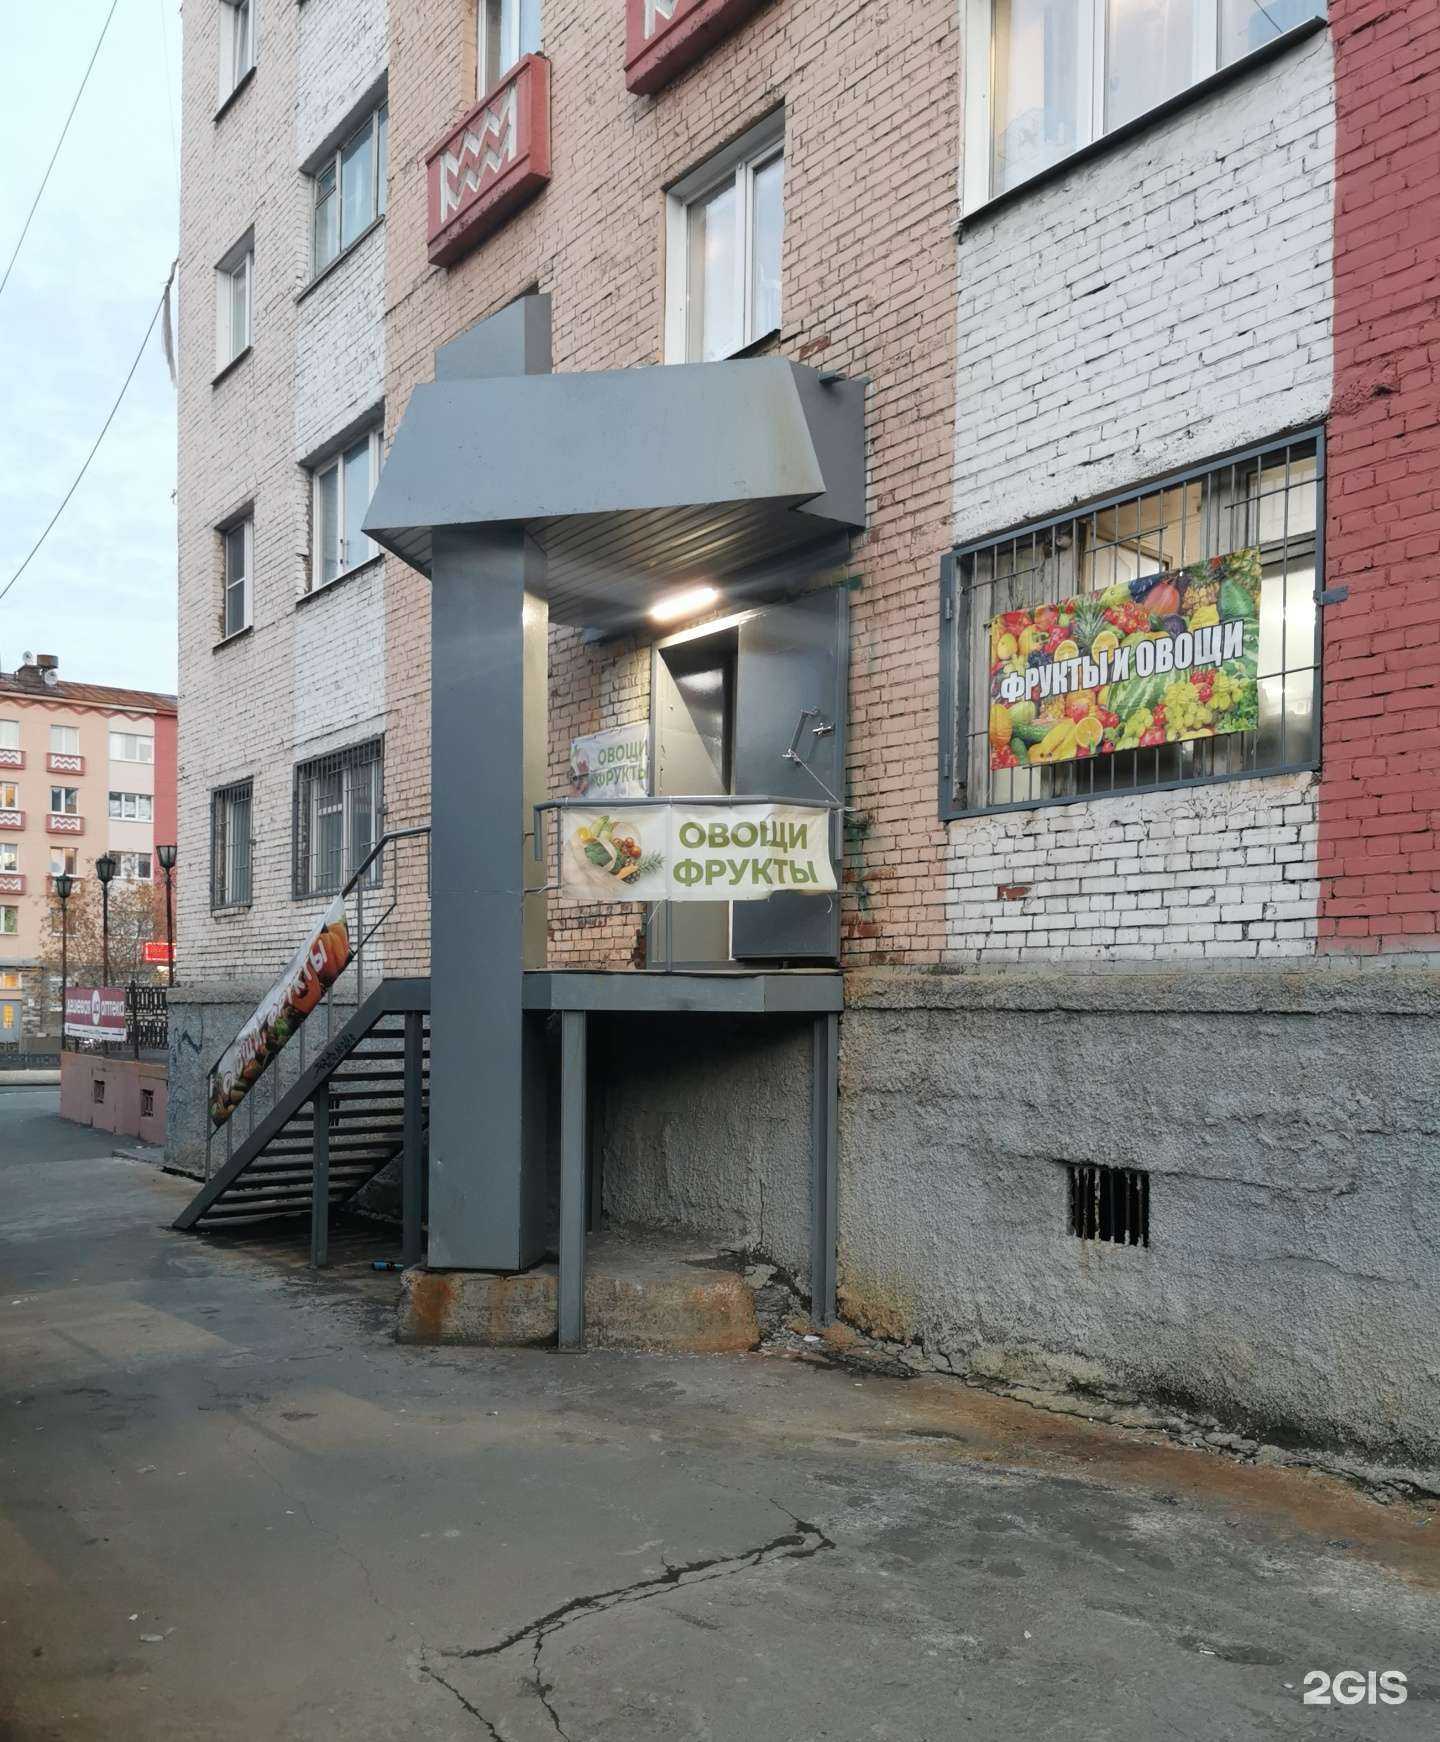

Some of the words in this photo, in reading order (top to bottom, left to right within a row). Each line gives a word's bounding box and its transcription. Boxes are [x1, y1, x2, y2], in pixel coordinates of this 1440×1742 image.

[1000, 649, 1108, 703] ФРУКТЫ
[1110, 645, 1131, 684] И
[1135, 619, 1245, 680] ОВОЩИ
[678, 820, 809, 853] ОВОЩИ
[672, 857, 819, 888] ФРУКТЫ
